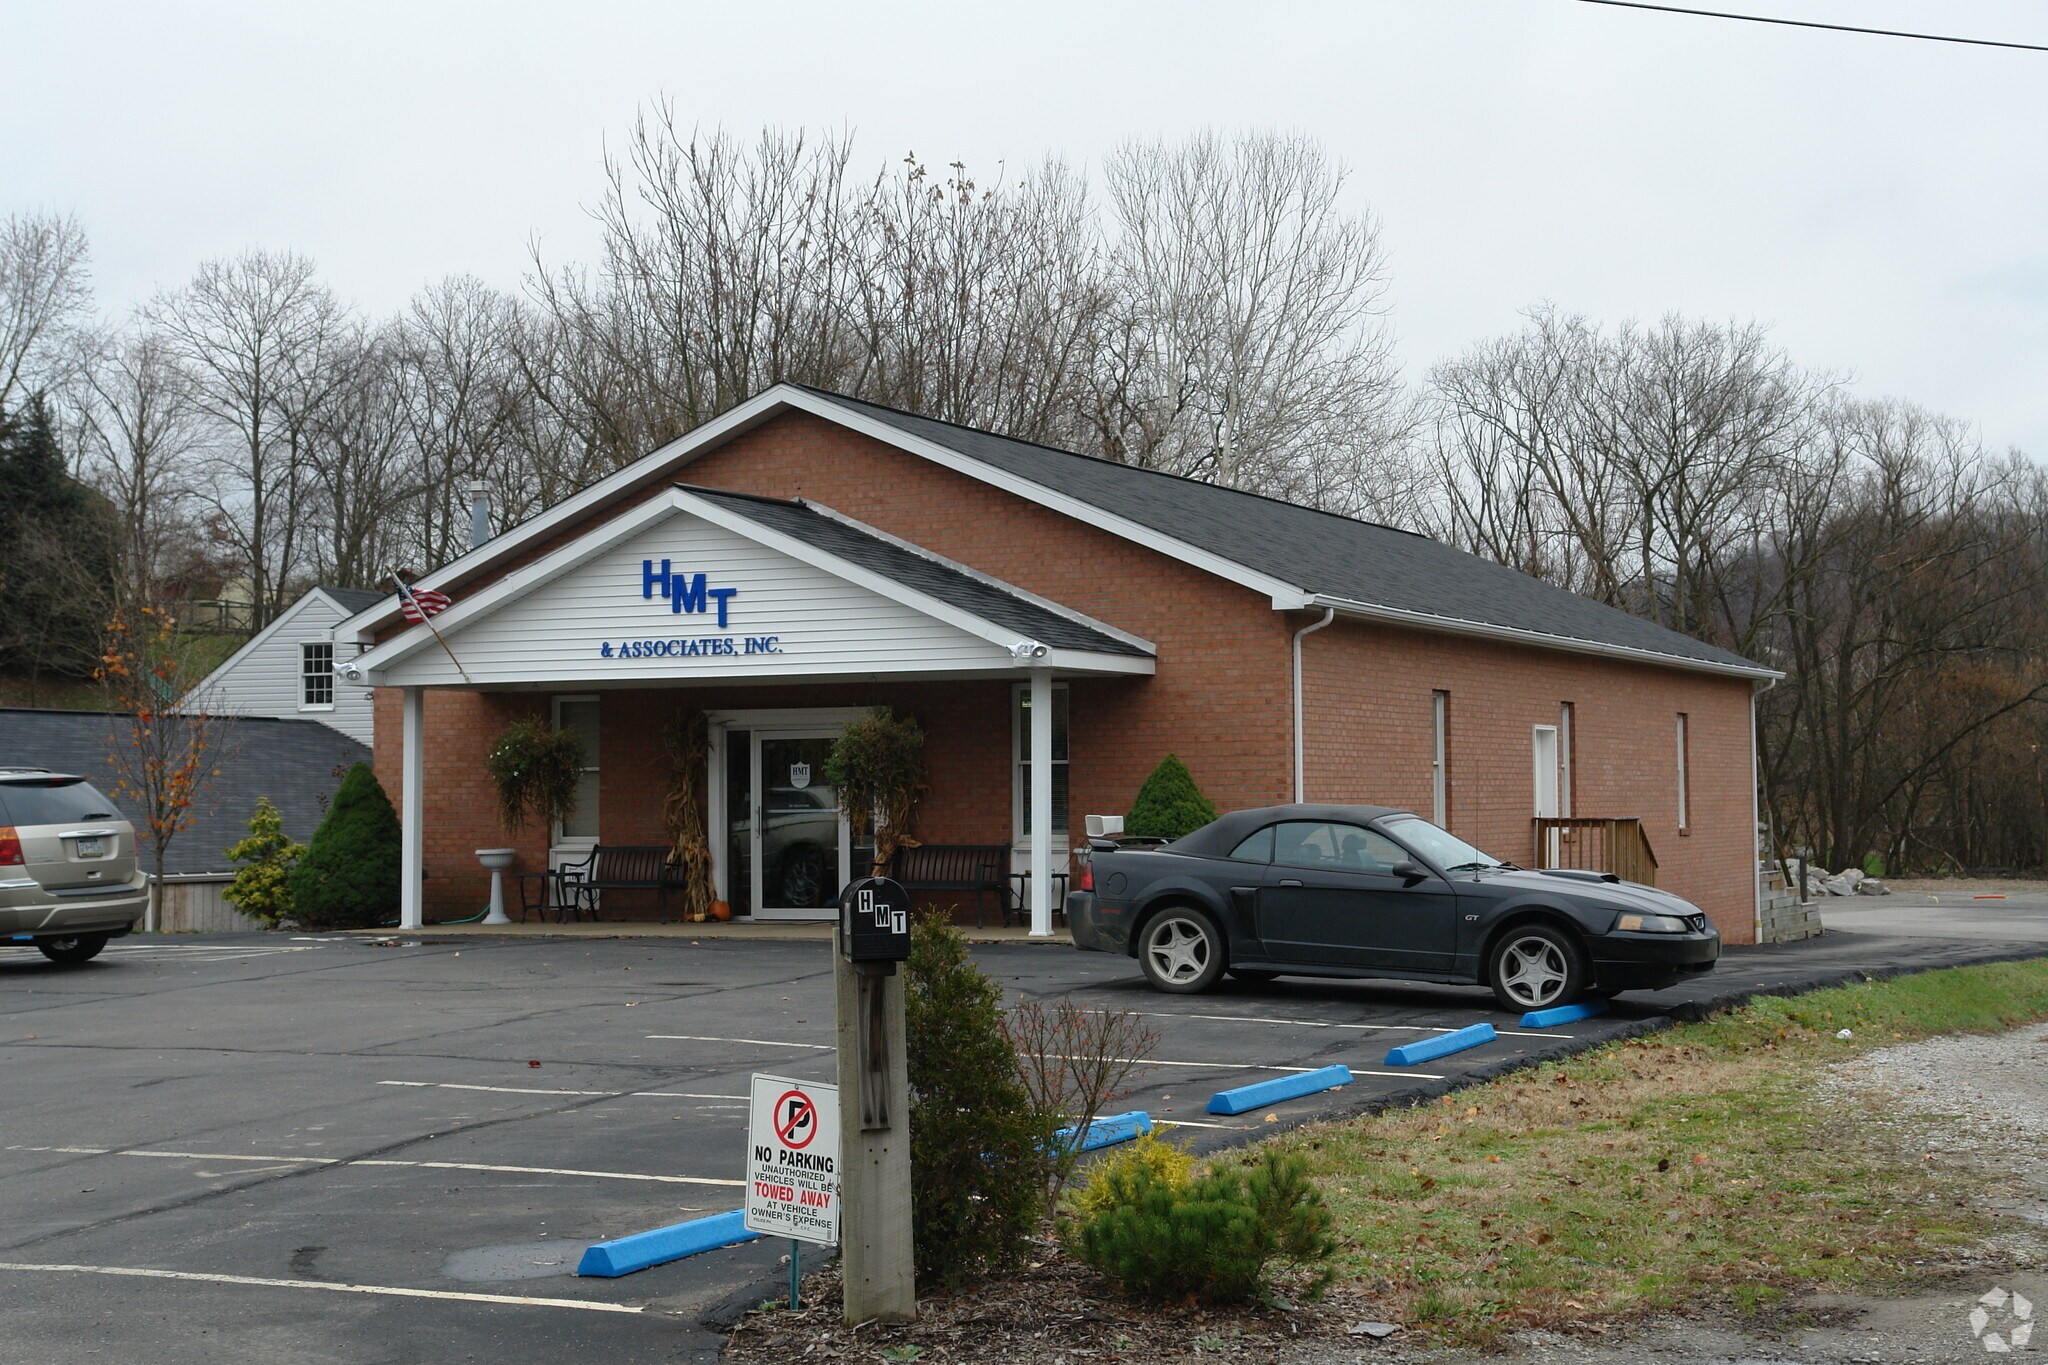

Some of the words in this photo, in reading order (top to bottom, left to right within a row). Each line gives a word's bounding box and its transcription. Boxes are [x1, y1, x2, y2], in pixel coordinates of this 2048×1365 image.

[643, 559, 737, 628] HMT
[601, 641, 613, 658] &
[618, 637, 738, 658] ASSOCIATES,
[744, 636, 783, 654] INC.
[793, 767, 808, 775] HMT
[860, 892, 904, 932] HMT
[755, 1145, 772, 1162] NO
[780, 1149, 834, 1173] PARKING
[755, 1172, 794, 1186] VEHICLES
[798, 1179, 818, 1190] WILL
[821, 1183, 833, 1193] BE
[762, 1164, 825, 1182] UNAUTHORIZED
[755, 1182, 794, 1202] TOWED
[800, 1190, 830, 1208] AWAY
[751, 1207, 791, 1221] OWNER'S
[793, 1214, 832, 1229] EXPENSE
[767, 1201, 777, 1209] AT
[781, 1203, 817, 1217] VEHICLE
